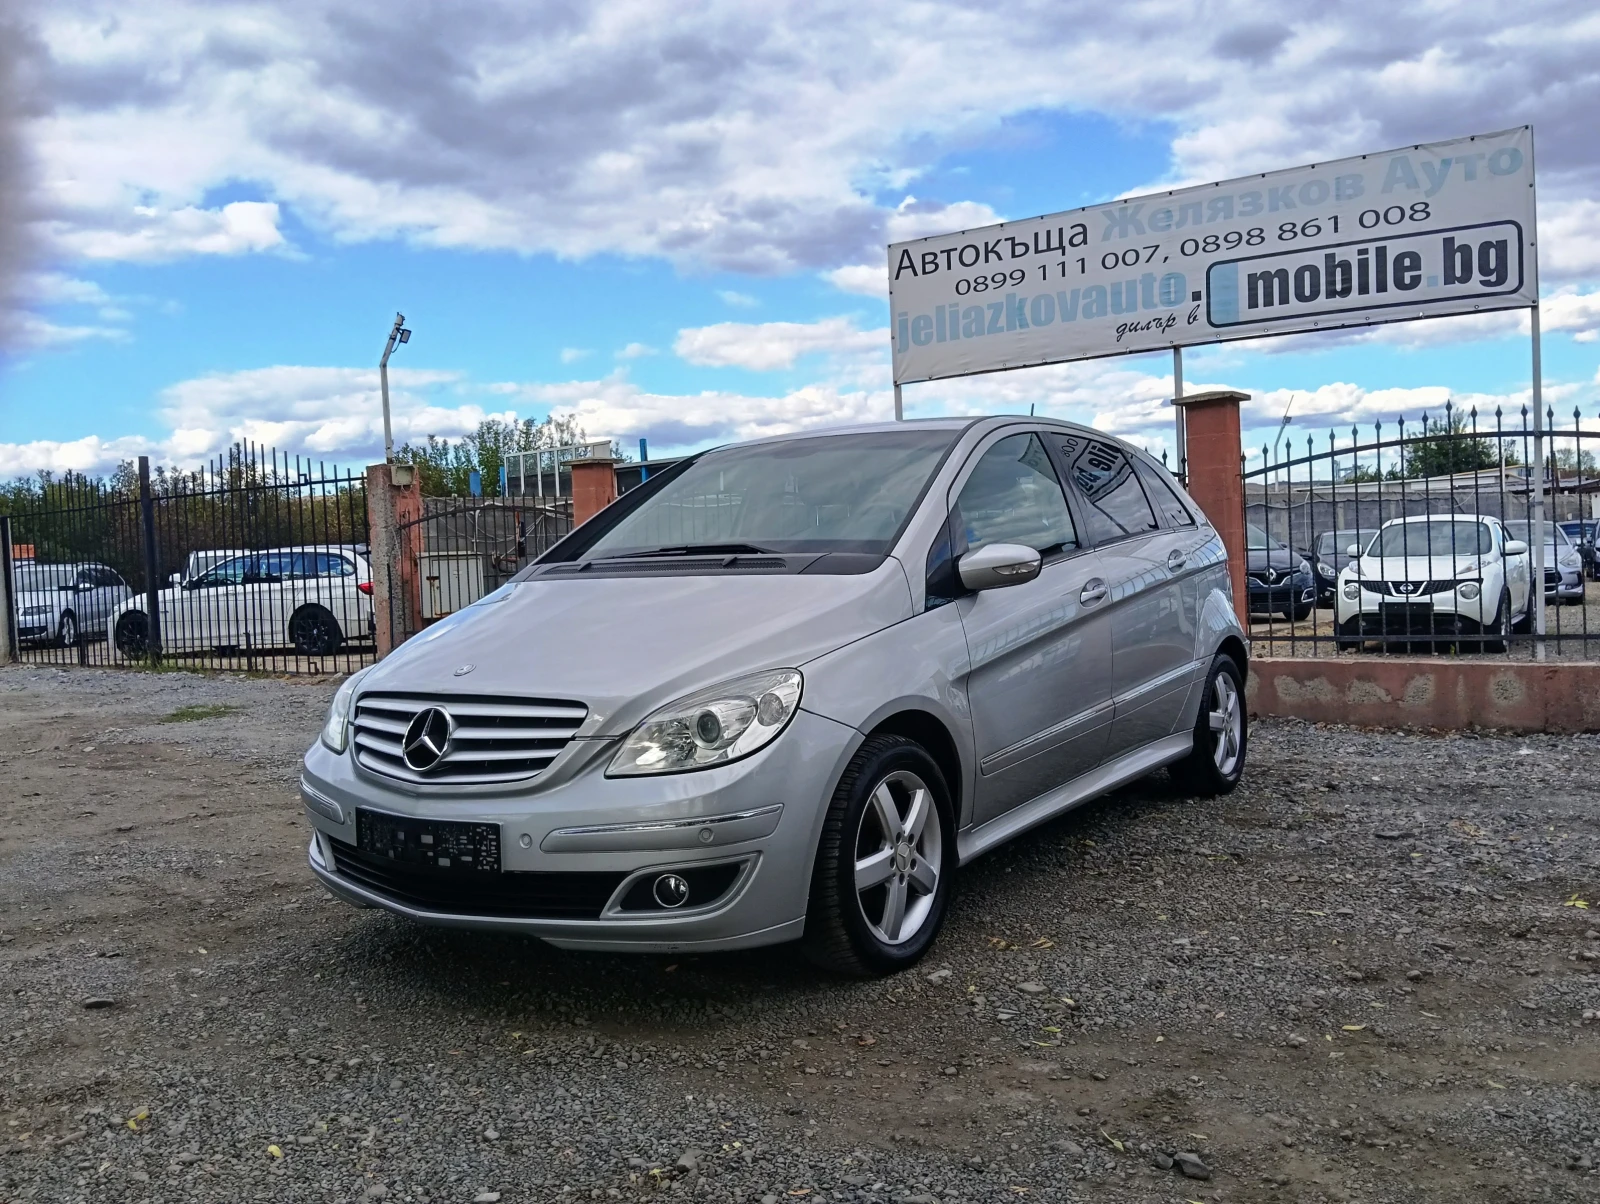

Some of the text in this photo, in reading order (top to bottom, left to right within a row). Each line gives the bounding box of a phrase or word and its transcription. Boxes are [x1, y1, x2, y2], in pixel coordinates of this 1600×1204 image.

[894, 147, 1524, 281] Автокъща Желязков Ауто
[955, 201, 1431, 296] 0899 111 007, 0898 861 008
[1247, 236, 1509, 310] mobile.bg
[1116, 303, 1201, 342] дилър в
